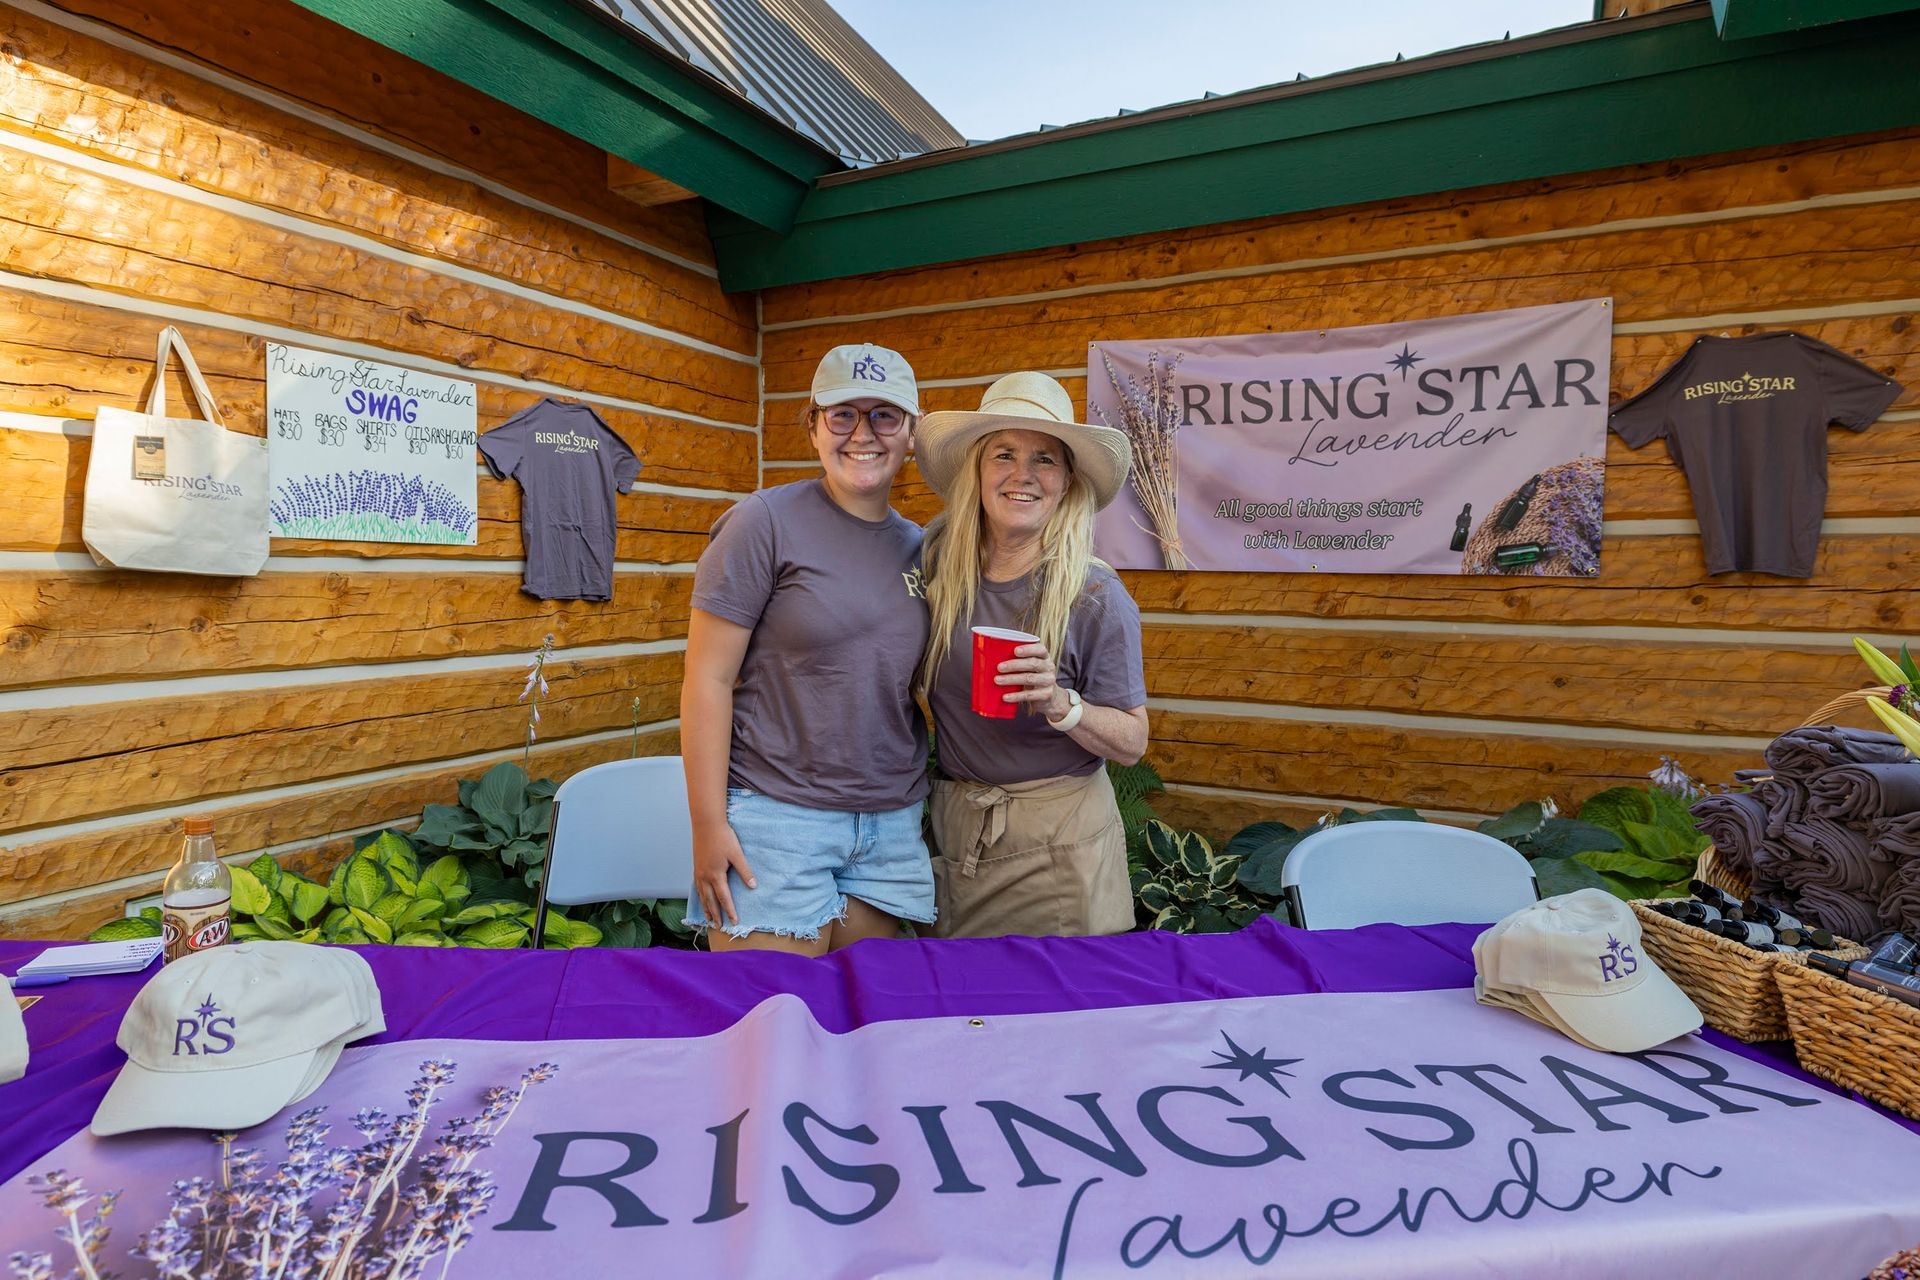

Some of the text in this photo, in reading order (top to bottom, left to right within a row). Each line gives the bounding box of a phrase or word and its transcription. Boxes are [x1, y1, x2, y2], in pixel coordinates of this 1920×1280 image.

[270, 345, 474, 407] Rising Star Lavender
[852, 361, 886, 383] RS
[1684, 377, 1796, 400] RISING STAR
[345, 389, 419, 424] SWAG
[1179, 358, 1601, 426] RISING STAR
[273, 408, 301, 422] HATS
[314, 413, 348, 431] BAGS
[355, 418, 398, 438] SHIRTS
[404, 426, 431, 443] OILS
[278, 420, 464, 460] $30 $30 $34 $30 $50
[535, 432, 599, 450] RISING STAR
[1288, 412, 1518, 467] Lavender
[210, 482, 243, 496] STAR
[1214, 498, 1423, 522] All good things start
[1244, 530, 1394, 550] with Lavender
[1598, 944, 1638, 982] RS
[172, 1016, 236, 1056] RS
[492, 1050, 1822, 1231] RISING STAR
